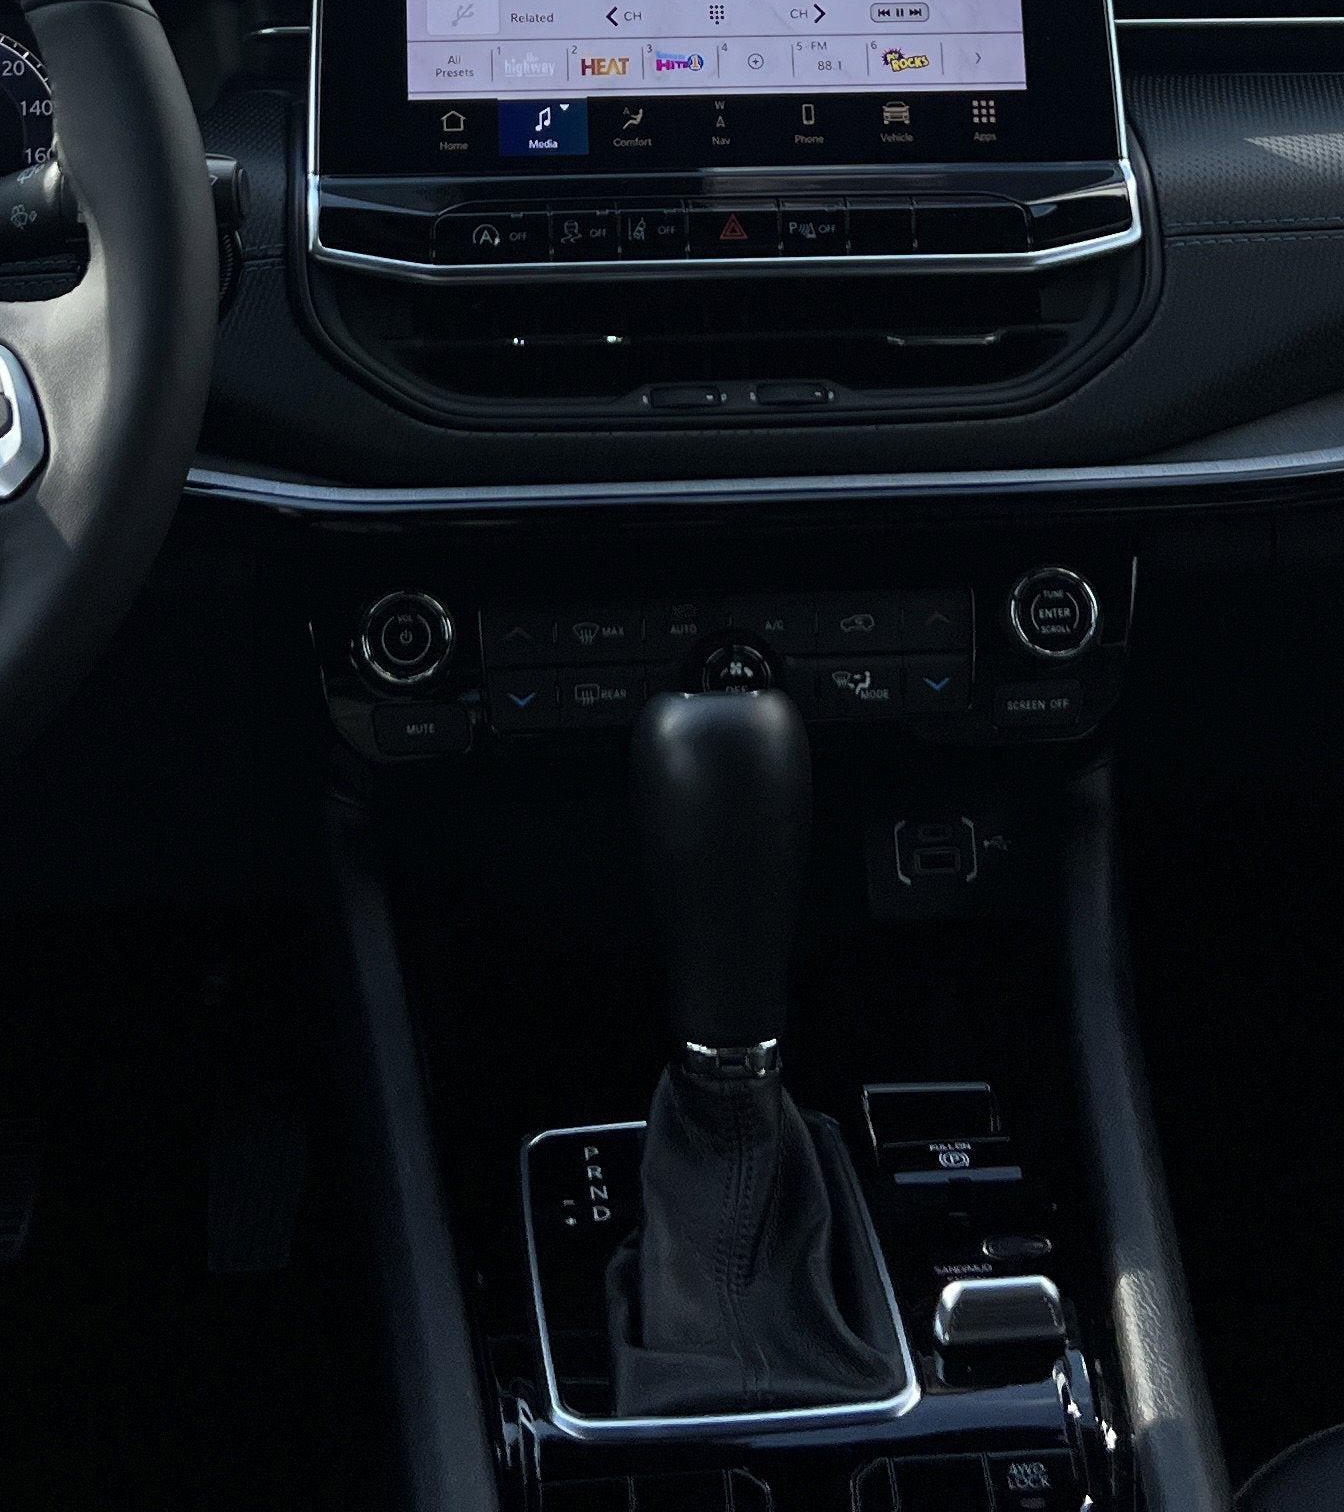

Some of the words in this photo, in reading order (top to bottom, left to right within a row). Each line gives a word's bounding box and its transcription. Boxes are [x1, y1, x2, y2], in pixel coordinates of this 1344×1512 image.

[510, 13, 554, 23] Related
[624, 11, 642, 21] CH
[790, 8, 808, 19] CH
[571, 46, 578, 54] 2
[647, 44, 653, 53] 3
[721, 43, 728, 52] 4
[810, 41, 828, 51] FM
[870, 41, 877, 50] 6
[447, 55, 461, 65] All
[892, 56, 929, 72] ROCKS
[580, 58, 630, 76] HEAT
[817, 60, 842, 71] 88.1
[435, 67, 474, 78] Presets
[20, 100, 53, 116] 140
[712, 136, 730, 145] Nav
[794, 134, 824, 144] Phone
[880, 132, 913, 142] Vehicle
[974, 132, 997, 142] Apps
[439, 141, 468, 150] Home
[528, 139, 558, 149] Media
[613, 138, 652, 147] Comfort
[589, 229, 607, 238] OFF
[658, 225, 675, 235] OFF
[818, 224, 836, 234] OFF
[509, 231, 527, 241] OFF
[1039, 608, 1070, 618] ENTER
[602, 625, 625, 636] MAX
[670, 623, 697, 634] AUTO
[1041, 625, 1070, 635] SCROLL
[861, 689, 888, 700] MODE
[1007, 700, 1045, 711] SCREEN
[1051, 698, 1070, 710] OFF
[406, 723, 435, 735] MUTE
[584, 1146, 599, 1161] P
[587, 1165, 603, 1180] R
[590, 1185, 609, 1200] N
[593, 1205, 611, 1221] D
